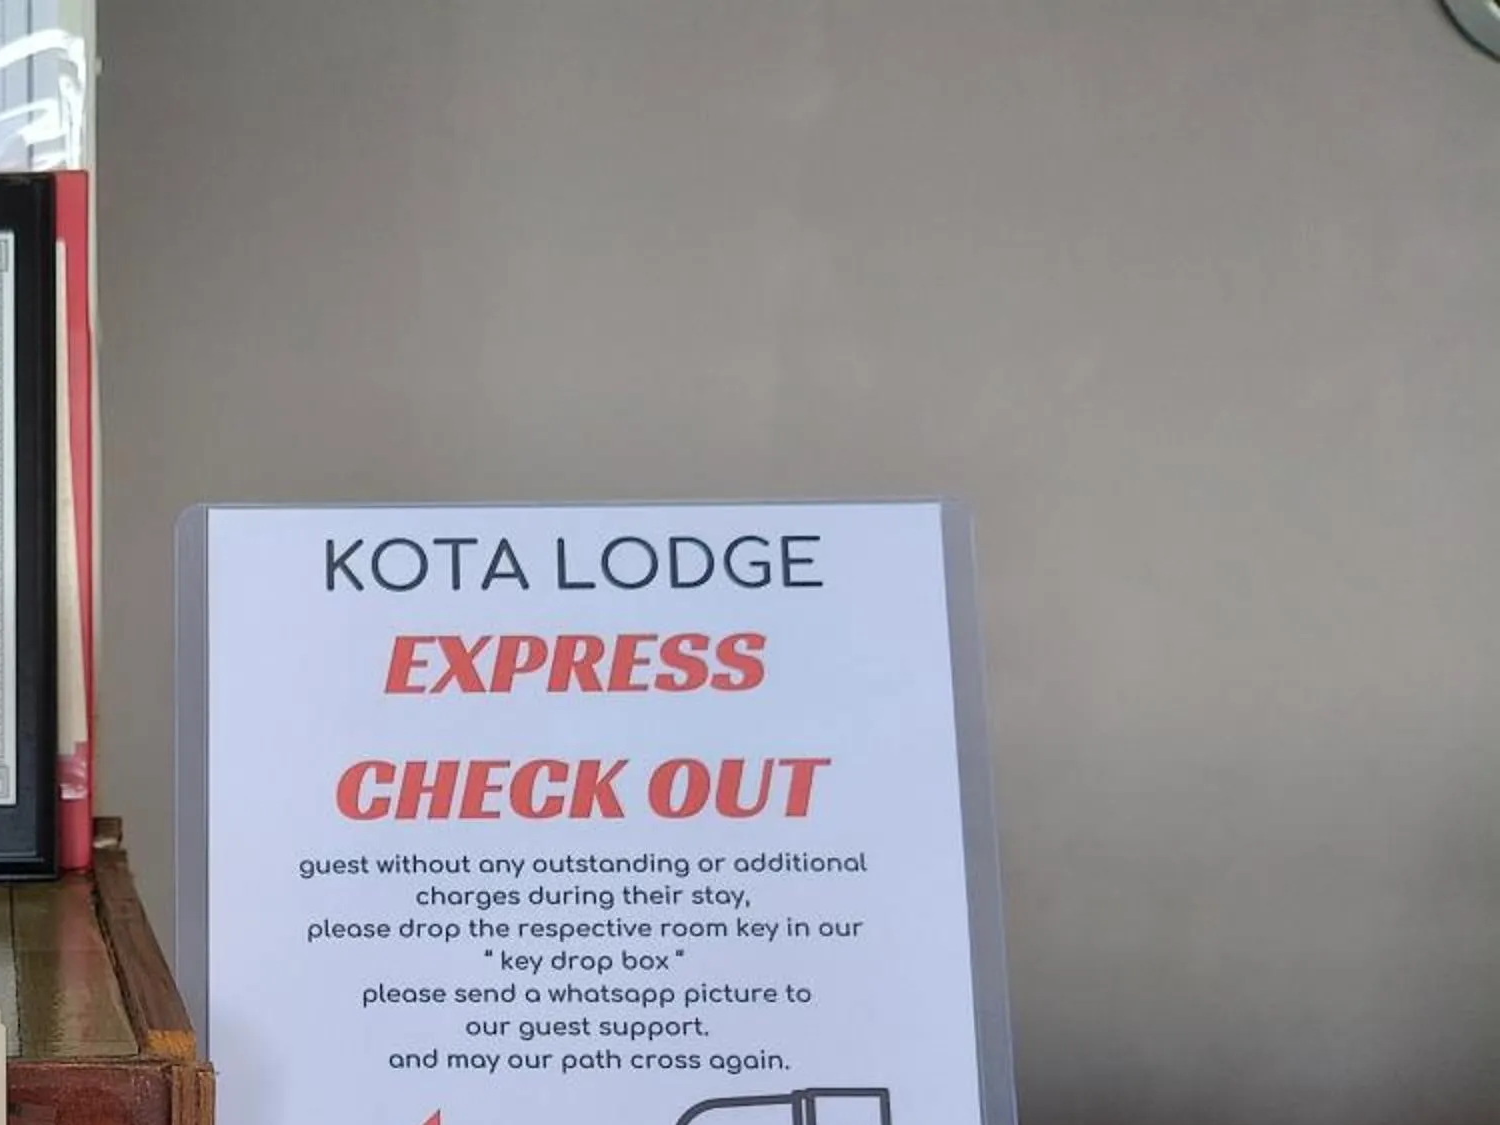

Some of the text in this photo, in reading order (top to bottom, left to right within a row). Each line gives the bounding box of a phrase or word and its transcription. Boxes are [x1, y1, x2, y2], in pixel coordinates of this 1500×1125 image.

[326, 535, 824, 592] KOTA LODGE
[384, 632, 767, 694] EXPRESS
[336, 757, 832, 821] CHECK OUT
[299, 852, 868, 880] guest without any outstanding or additional
[416, 885, 751, 911] charges during their stay,
[307, 917, 863, 943] please drop the respective room key in our
[551, 950, 613, 975] drop
[362, 982, 812, 1008] please send a whatsapp picture to
[465, 1016, 709, 1041] our guest support.
[389, 1048, 790, 1075] and may our path cross again.
